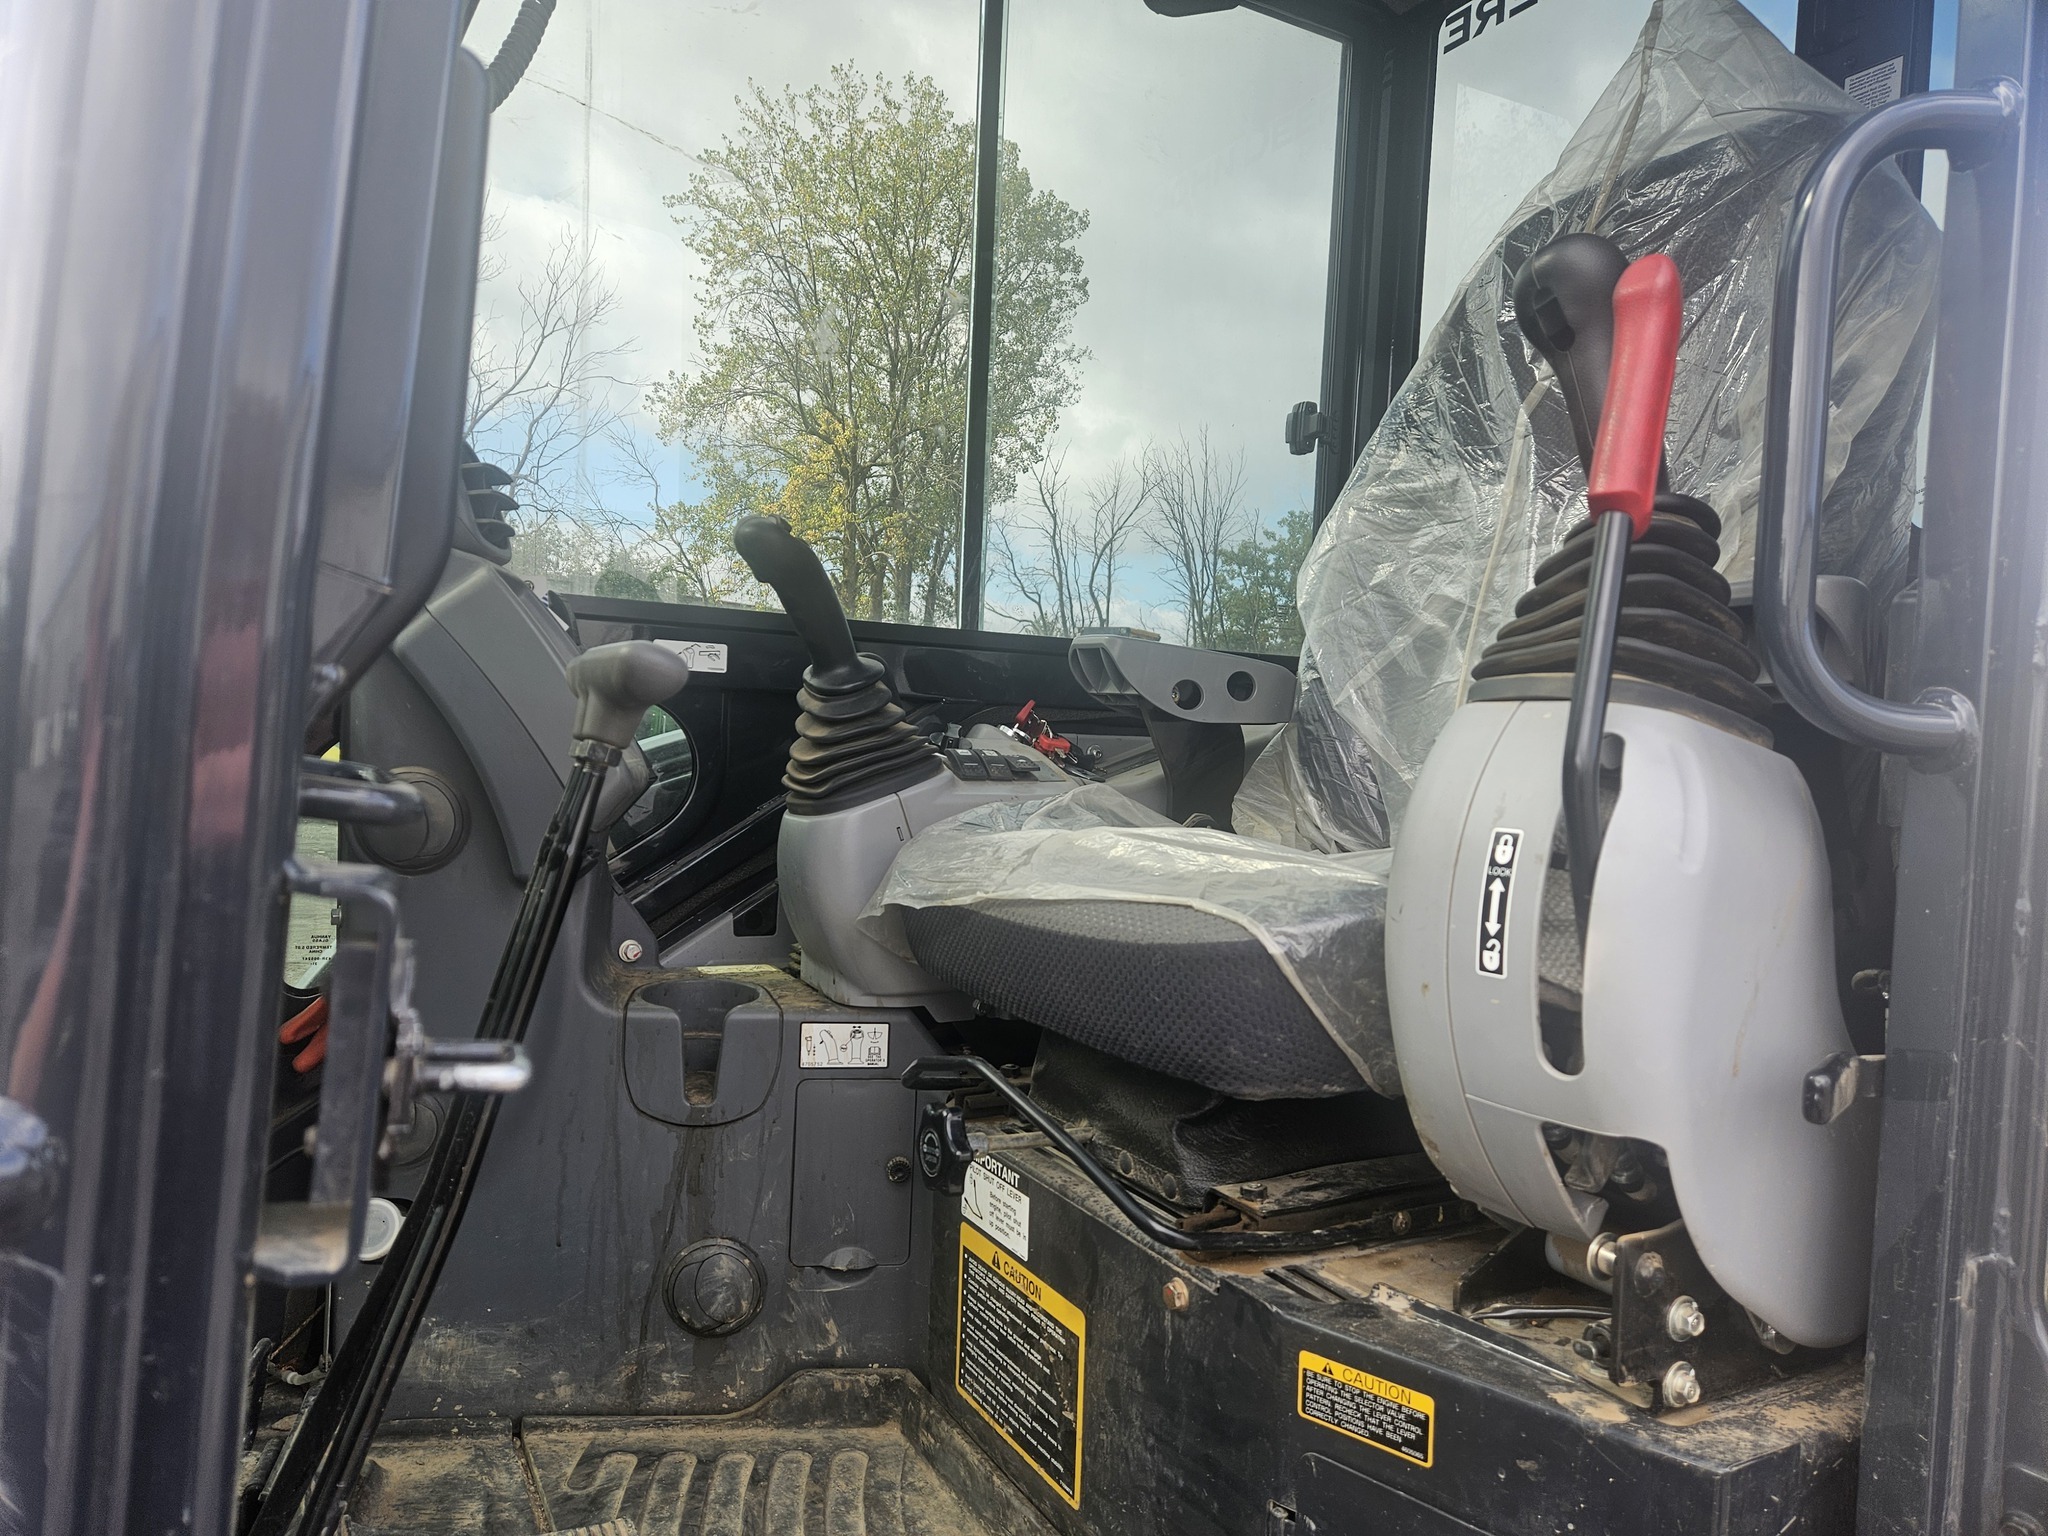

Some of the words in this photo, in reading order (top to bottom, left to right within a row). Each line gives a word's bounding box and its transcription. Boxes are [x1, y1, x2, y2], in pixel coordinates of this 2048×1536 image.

[974, 1155, 1021, 1188] PORTANT
[1006, 1187, 1021, 1204] LEVER
[1003, 1259, 1041, 1301] CAUTION
[1306, 1376, 1337, 1395] OPERATING
[1340, 1390, 1352, 1400] THE
[1354, 1395, 1383, 1412] SELECTOR
[1306, 1369, 1314, 1378] BE
[1316, 1373, 1332, 1385] SURE
[1334, 1380, 1341, 1388] TO
[1344, 1384, 1360, 1396] STOP
[1363, 1391, 1375, 1401] THE
[1376, 1396, 1399, 1410] ENGINE
[1401, 1405, 1426, 1421] BEFORE
[1342, 1367, 1411, 1405] CAUTION
[1305, 1383, 1323, 1396] AFTER
[1325, 1391, 1356, 1410] CHANGING
[1359, 1404, 1370, 1415] THE
[1372, 1409, 1391, 1423] LEVER
[1393, 1417, 1423, 1436] CONTROL
[1305, 1405, 1337, 1425] CORRECTLY
[1305, 1398, 1332, 1415] CONTROL
[1334, 1410, 1364, 1428] POSITIONS
[1367, 1423, 1383, 1435] HAVE
[1334, 1402, 1360, 1419] RECHECK
[1364, 1414, 1378, 1426] THAT
[1382, 1421, 1394, 1432] THE
[1396, 1426, 1415, 1440] LEVER
